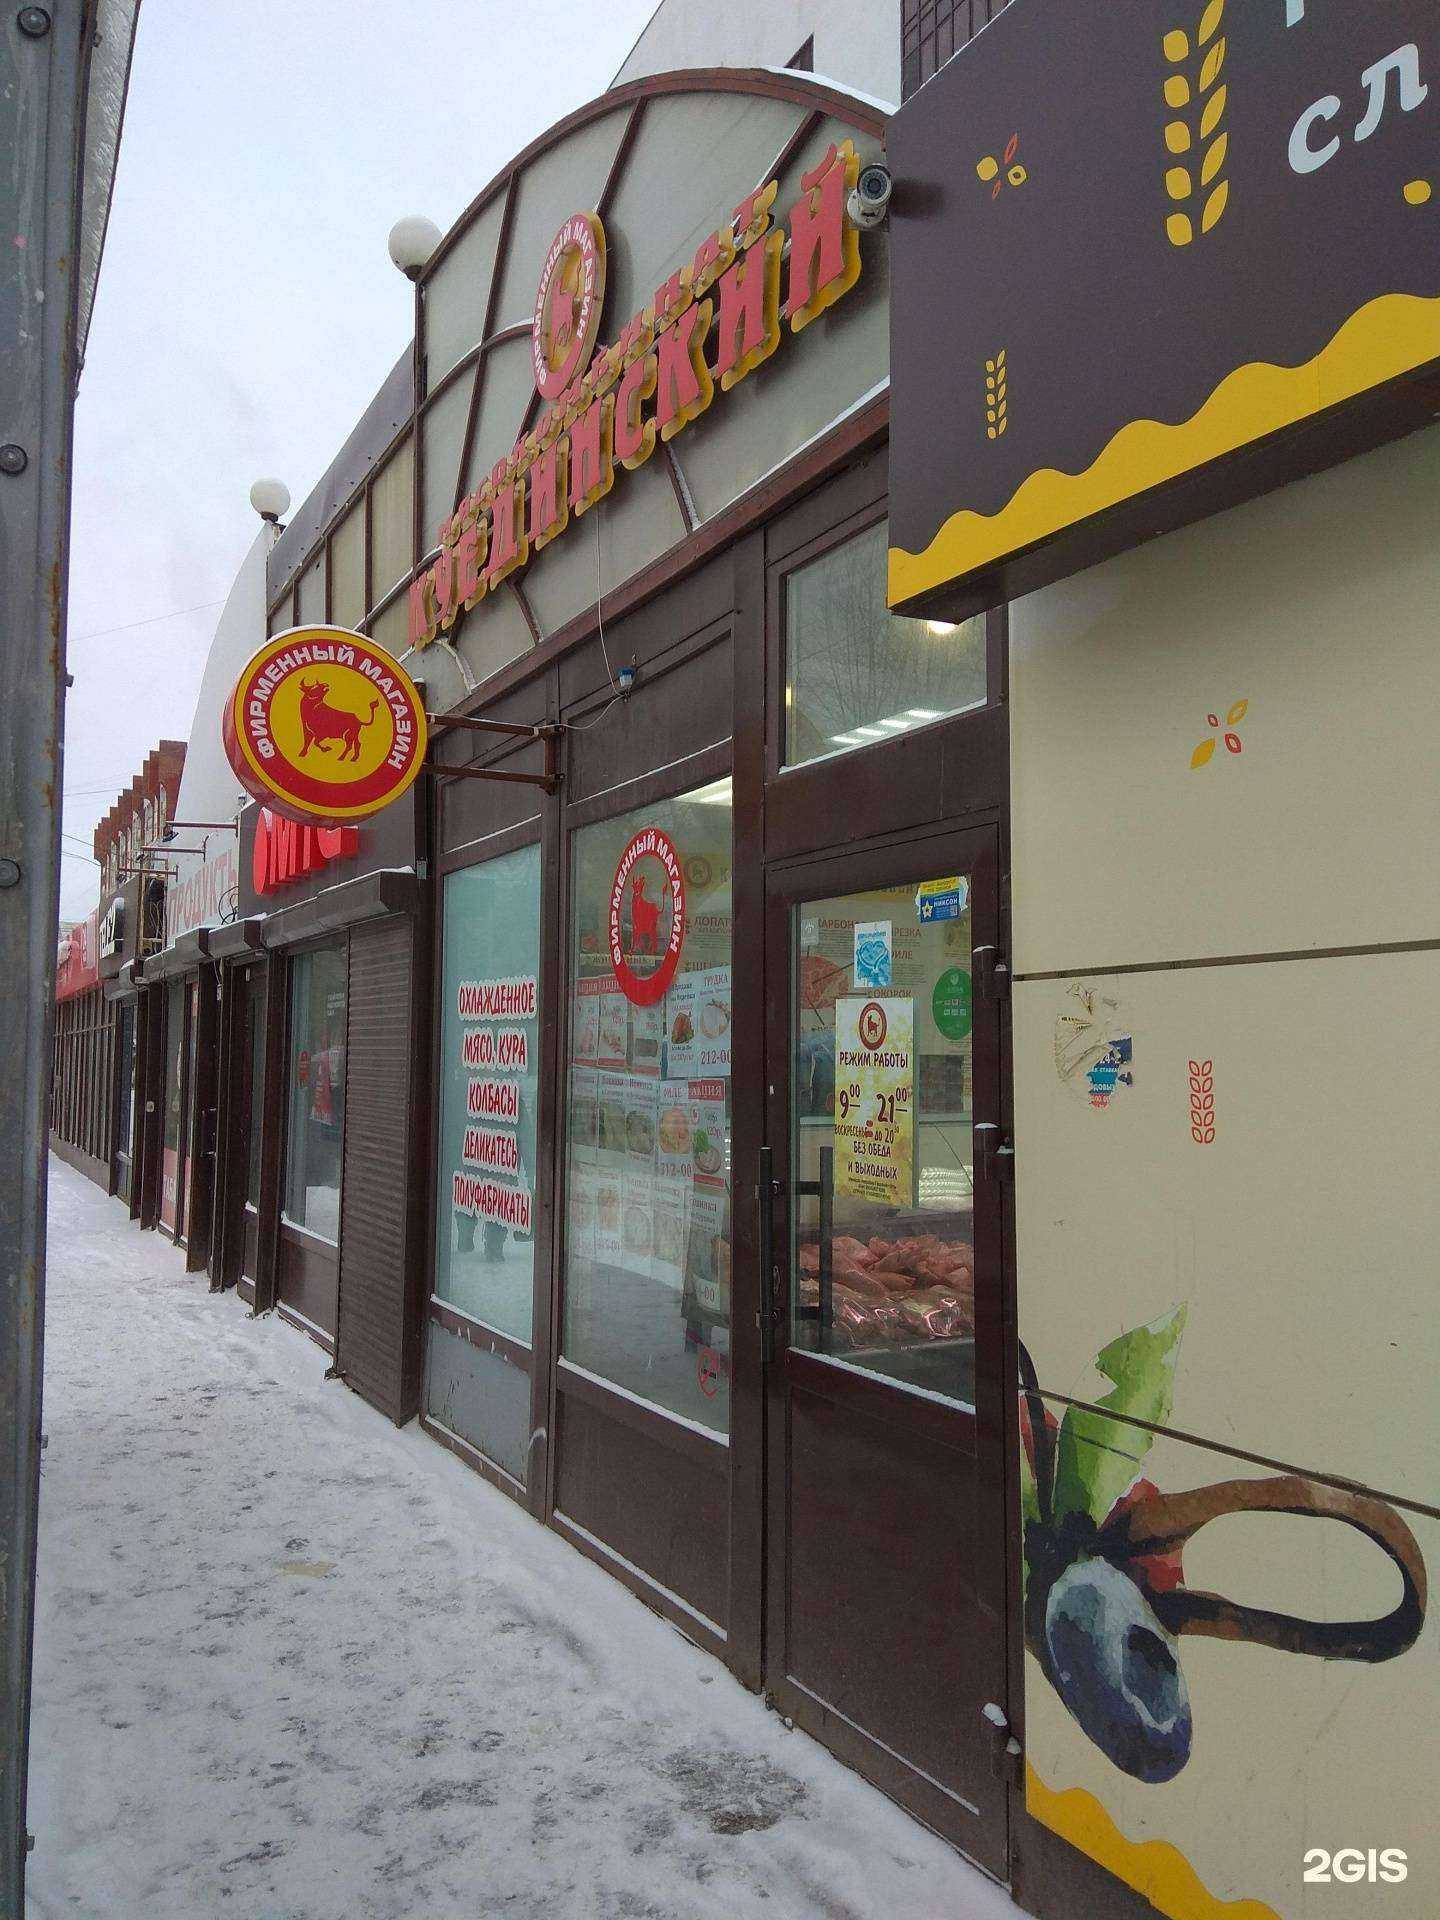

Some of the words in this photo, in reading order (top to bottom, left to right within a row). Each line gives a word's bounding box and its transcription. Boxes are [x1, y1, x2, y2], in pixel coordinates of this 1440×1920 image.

[533, 220, 574, 386] ФИРМЕННЫЙ
[573, 224, 596, 341] МАГАЗИН
[408, 142, 856, 650] КУЕДИНСКИЙ
[250, 644, 355, 759] ФИРМЕННЫЙ
[359, 658, 412, 770] МАГАЗИН
[611, 830, 656, 965] ФИРМЕННЫЙ
[656, 838, 682, 953] МАГАЗИН
[459, 982, 535, 1016] ОХЛАЖДЕННОЕ
[499, 1034, 526, 1066] КУРА
[840, 1051, 871, 1067] РЕЖИМ
[874, 1051, 908, 1069] РАБОТЫ
[469, 1083, 518, 1117] КОЛБАСЫ
[853, 1141, 866, 1154] БЕЗ
[868, 1143, 891, 1158] ОБЕДА
[848, 1161, 853, 1173] И
[855, 1162, 898, 1180] ВЫХОДНЫХ
[454, 1175, 530, 1228] ПОЛУФАБРИКАТЫ
